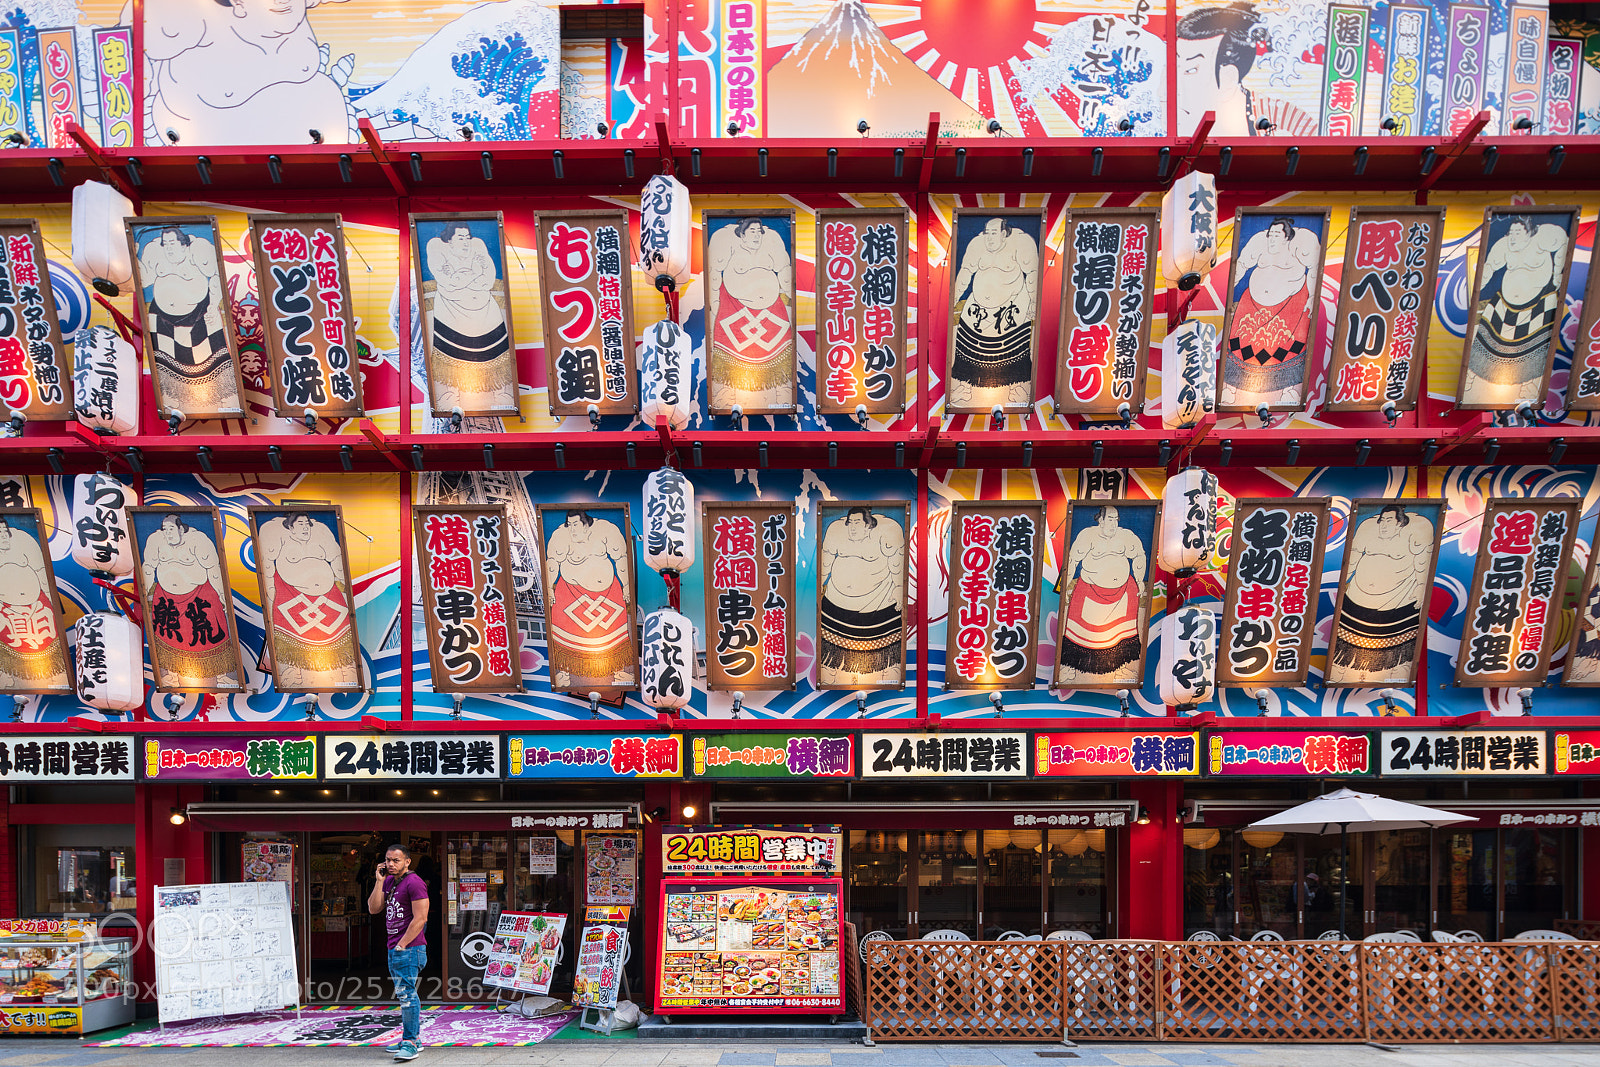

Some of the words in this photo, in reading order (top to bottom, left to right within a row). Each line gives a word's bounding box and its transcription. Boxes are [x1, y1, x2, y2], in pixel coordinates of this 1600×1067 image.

[102, 37, 132, 147] 串かつ
[727, 3, 757, 138] 日本一の串か
[9, 235, 63, 404] 新鮮ネタが勢揃い
[312, 231, 355, 401] 大阪下町の味
[549, 224, 602, 402] もつ鍋
[825, 223, 858, 403] 海の幸山の幸
[862, 224, 896, 400] 横綱串かつ
[1112, 226, 1148, 398] 新鮮ネタが勢揃い
[1386, 222, 1430, 400] なにわの鉄板焼き
[427, 515, 481, 682] 横綱串かつ
[475, 517, 512, 676] ボリューム横綱級
[714, 517, 758, 677] 横綱串かつ
[762, 514, 788, 676] ボリューム横綱級
[955, 516, 994, 679] 海の幸山の幸
[992, 516, 1033, 676] 横綱串かつ
[1231, 510, 1288, 674] 名物串かつ
[1274, 513, 1316, 671] 横綱定番の一品
[1467, 512, 1536, 673] 逸品料理
[1515, 513, 1566, 669] 料理長自慢の
[161, 749, 245, 768] 日本一の串かつ
[247, 739, 315, 777] 横綱
[334, 740, 495, 775] 24時間営業
[511, 816, 588, 828] 日本一の串かつ
[525, 747, 609, 765] 日本一の串かつ
[610, 737, 680, 774] 横綱
[706, 748, 785, 765] 日本一の串かつ
[786, 737, 851, 774] 横綱
[872, 738, 1021, 772] 24時間営業
[1013, 814, 1090, 826] 日本一の串かつ
[1050, 745, 1131, 763] 日本一の串かつ
[1131, 735, 1197, 772] 横綱
[1223, 745, 1303, 764] 日本一の串かつ
[1303, 735, 1370, 773] 横綱
[1390, 736, 1539, 770] 24時間営業
[1500, 813, 1578, 825] 日本一の串かつ
[667, 834, 761, 863] 24時間
[762, 837, 827, 863] 営業中
